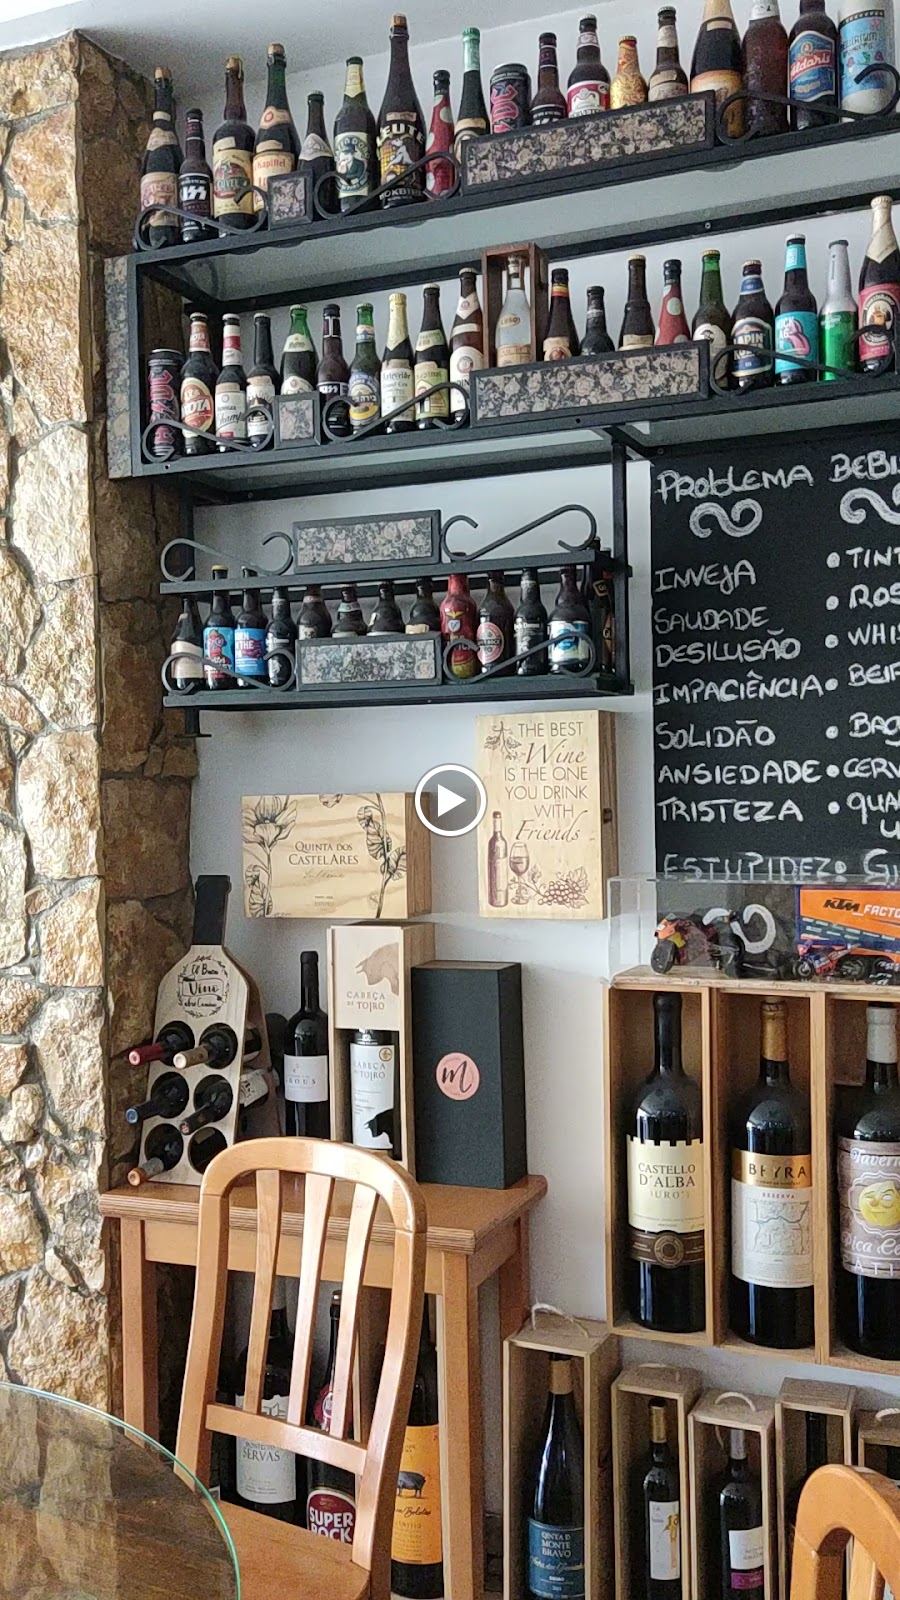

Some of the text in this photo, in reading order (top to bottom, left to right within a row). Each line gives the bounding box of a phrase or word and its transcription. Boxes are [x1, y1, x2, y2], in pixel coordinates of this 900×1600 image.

[829, 450, 900, 484] BEBI
[654, 559, 757, 595] INVEJA
[654, 606, 770, 634] SAUDADE
[656, 627, 801, 667] DESILUSÃO
[652, 669, 825, 706] IMPACIÊNCIA
[518, 721, 584, 738] THE BEST
[655, 719, 776, 750] SOLIDÃO
[526, 739, 587, 765] Wine
[504, 766, 588, 781] IS THE ONE
[658, 759, 822, 785] ANSIEDADE
[505, 785, 588, 800] YOU DRINK
[534, 804, 575, 819] WITH
[657, 796, 804, 823] TRISTEZA
[516, 809, 588, 842] Friends
[288, 853, 359, 865] CASTELARES
[663, 851, 831, 880] ESTUPIDEZ
[823, 897, 860, 912] KTM
[346, 991, 386, 1000] CABEÇA
[638, 1162, 696, 1174] CASTELLO
[243, 1449, 280, 1462] SERVAS
[309, 1506, 354, 1528] SUPER
[542, 1540, 571, 1549] MONTE
